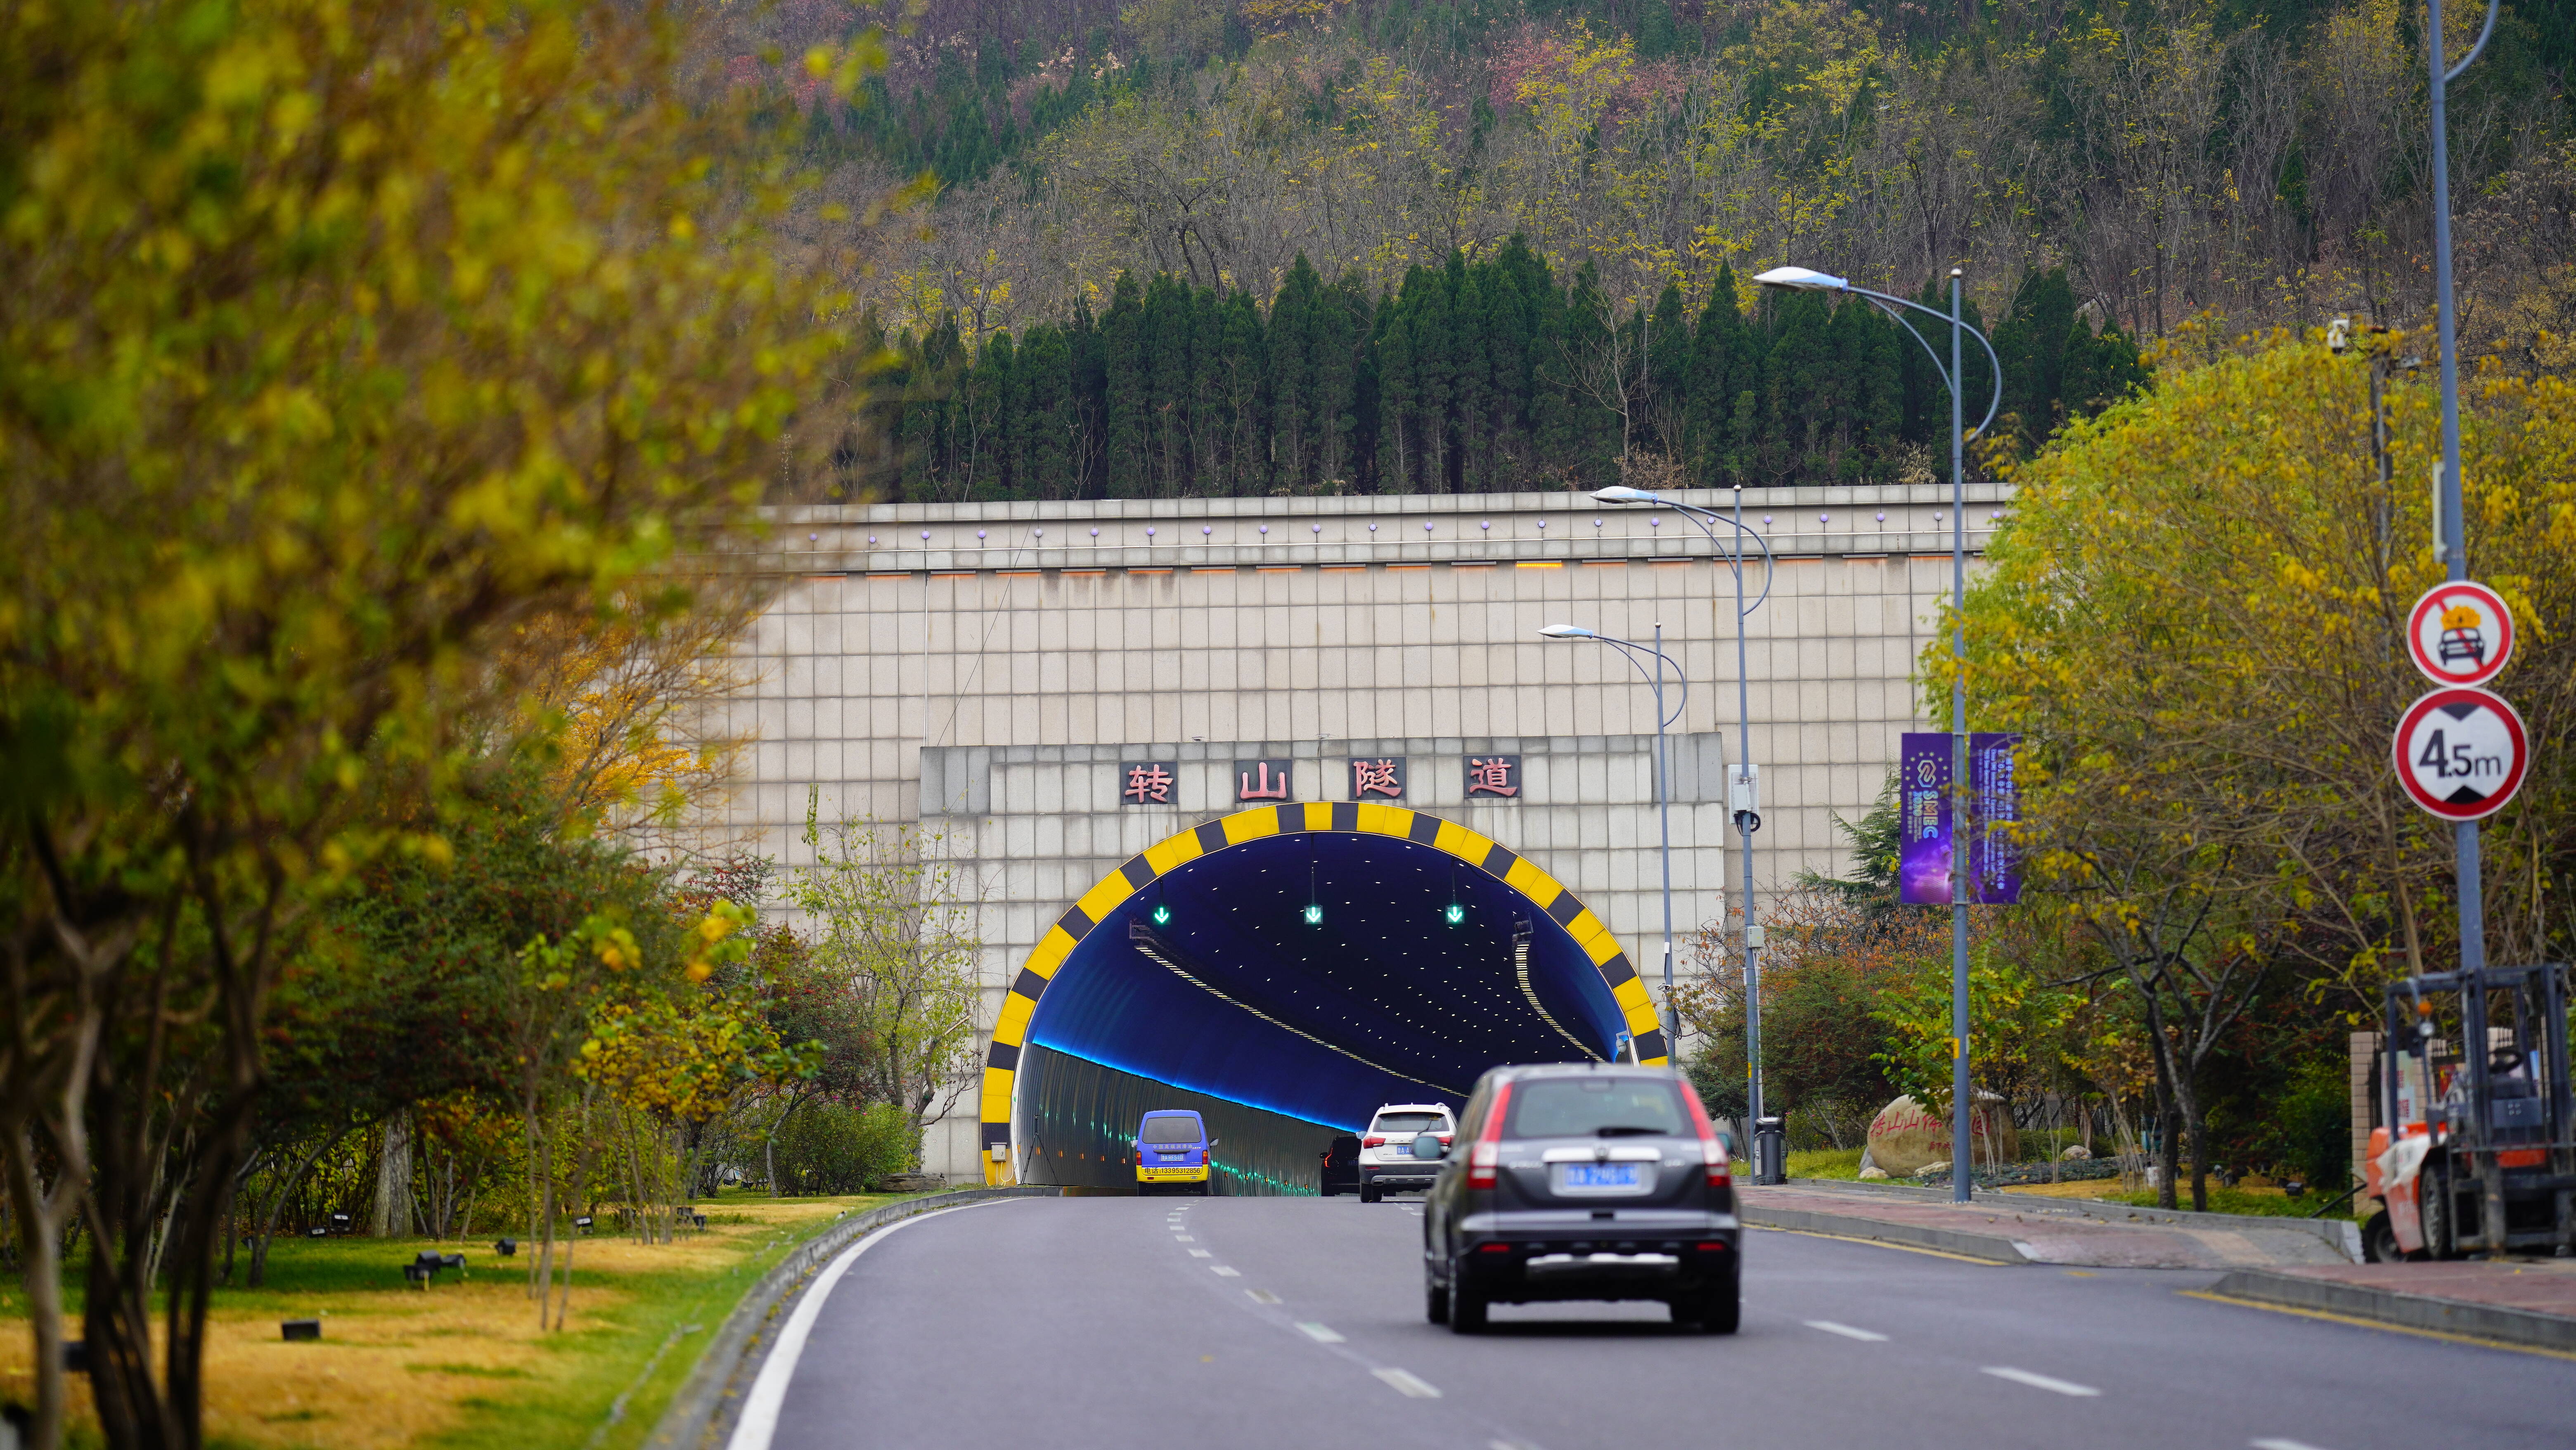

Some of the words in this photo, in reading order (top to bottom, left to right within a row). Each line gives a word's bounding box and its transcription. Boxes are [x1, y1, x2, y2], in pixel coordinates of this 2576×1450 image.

[2419, 729, 2500, 778] 4.5m
[1125, 758, 1517, 803] 转山隧道
[1913, 791, 1923, 817] 2020
[1923, 790, 1939, 839] SMEC
